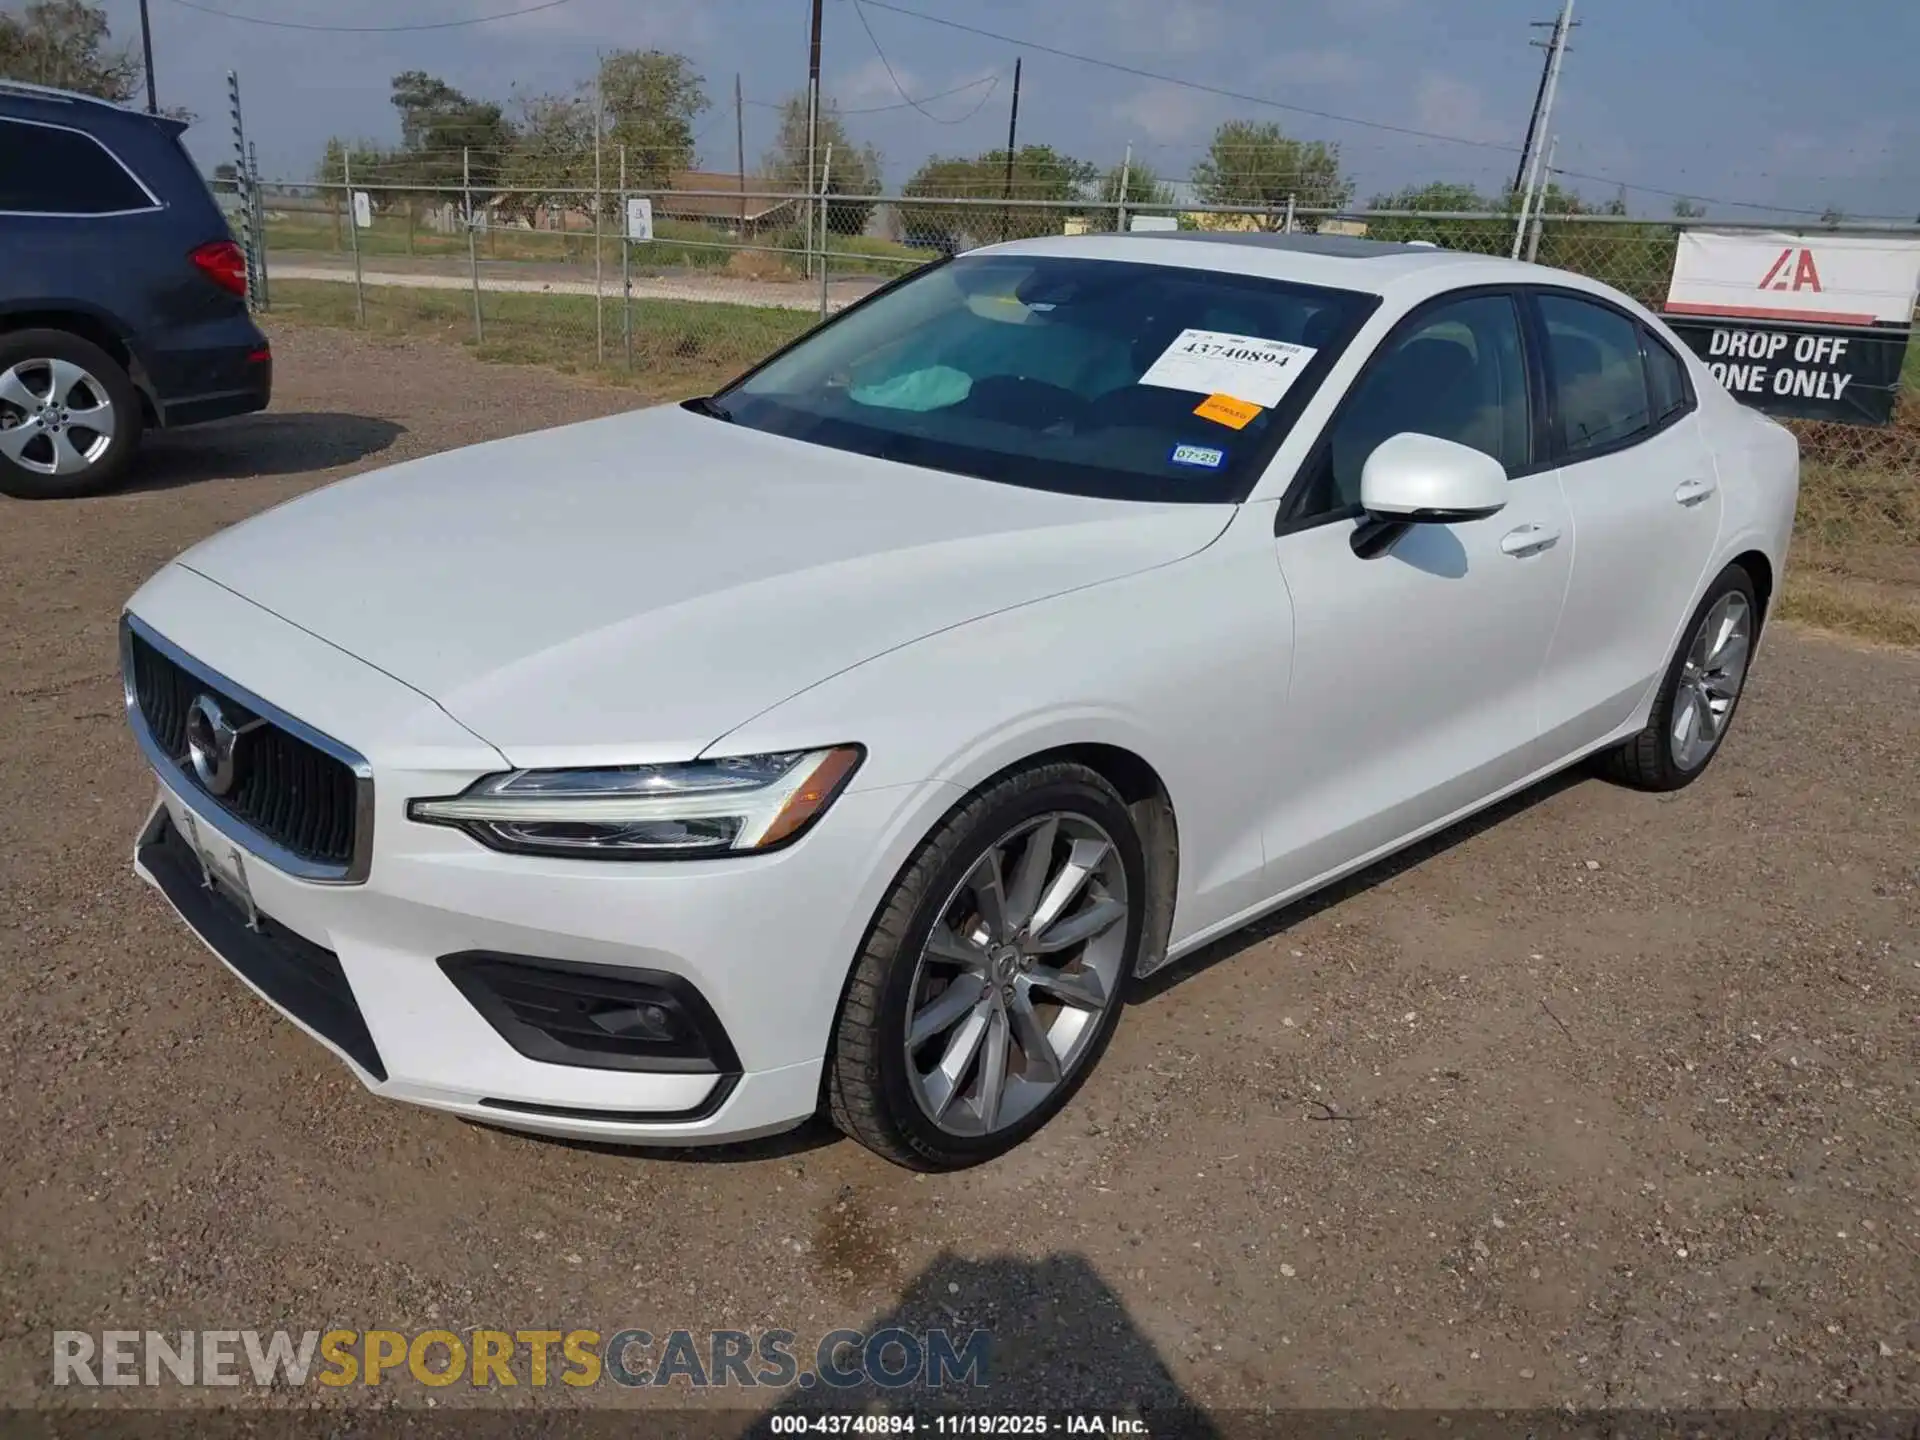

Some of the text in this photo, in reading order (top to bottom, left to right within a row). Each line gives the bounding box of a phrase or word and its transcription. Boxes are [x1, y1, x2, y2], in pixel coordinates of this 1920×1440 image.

[1183, 341, 1290, 368] 43740894
[1708, 328, 1849, 365] DROP OFF
[1701, 362, 1853, 401] ONE ONLY
[1175, 448, 1219, 464] 07-25
